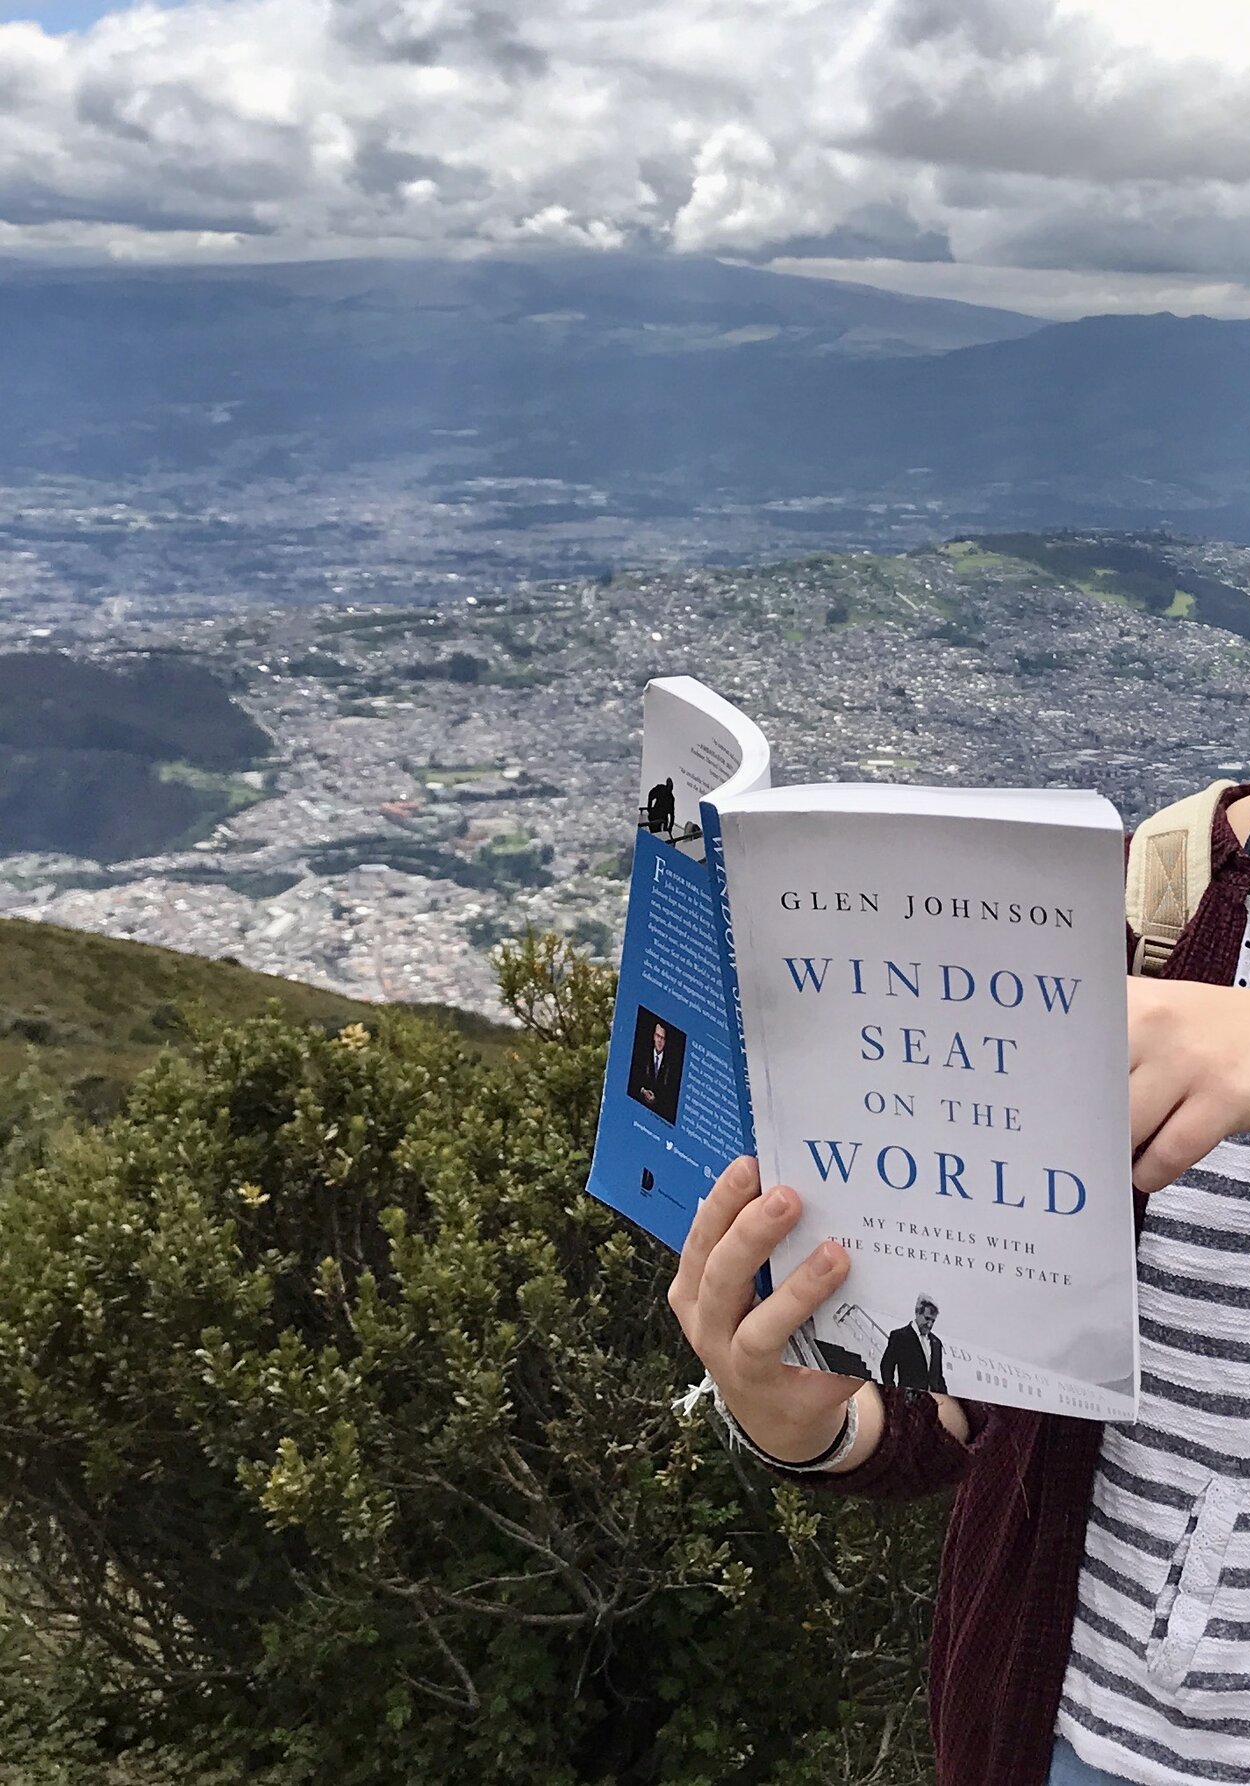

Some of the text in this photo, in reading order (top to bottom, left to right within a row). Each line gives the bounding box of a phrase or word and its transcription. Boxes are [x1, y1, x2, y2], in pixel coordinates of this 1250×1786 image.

[780, 891, 1075, 929] GLEN JOHNSON
[782, 956, 1083, 1015] WINDOW
[861, 1024, 1018, 1075] SEAT
[864, 1091, 1022, 1132] ON THE
[803, 1138, 1087, 1216] WORLD
[862, 1216, 1035, 1255] MY TRAVELS WITH
[827, 1236, 1073, 1286] THE SECRETARY OF STATE
